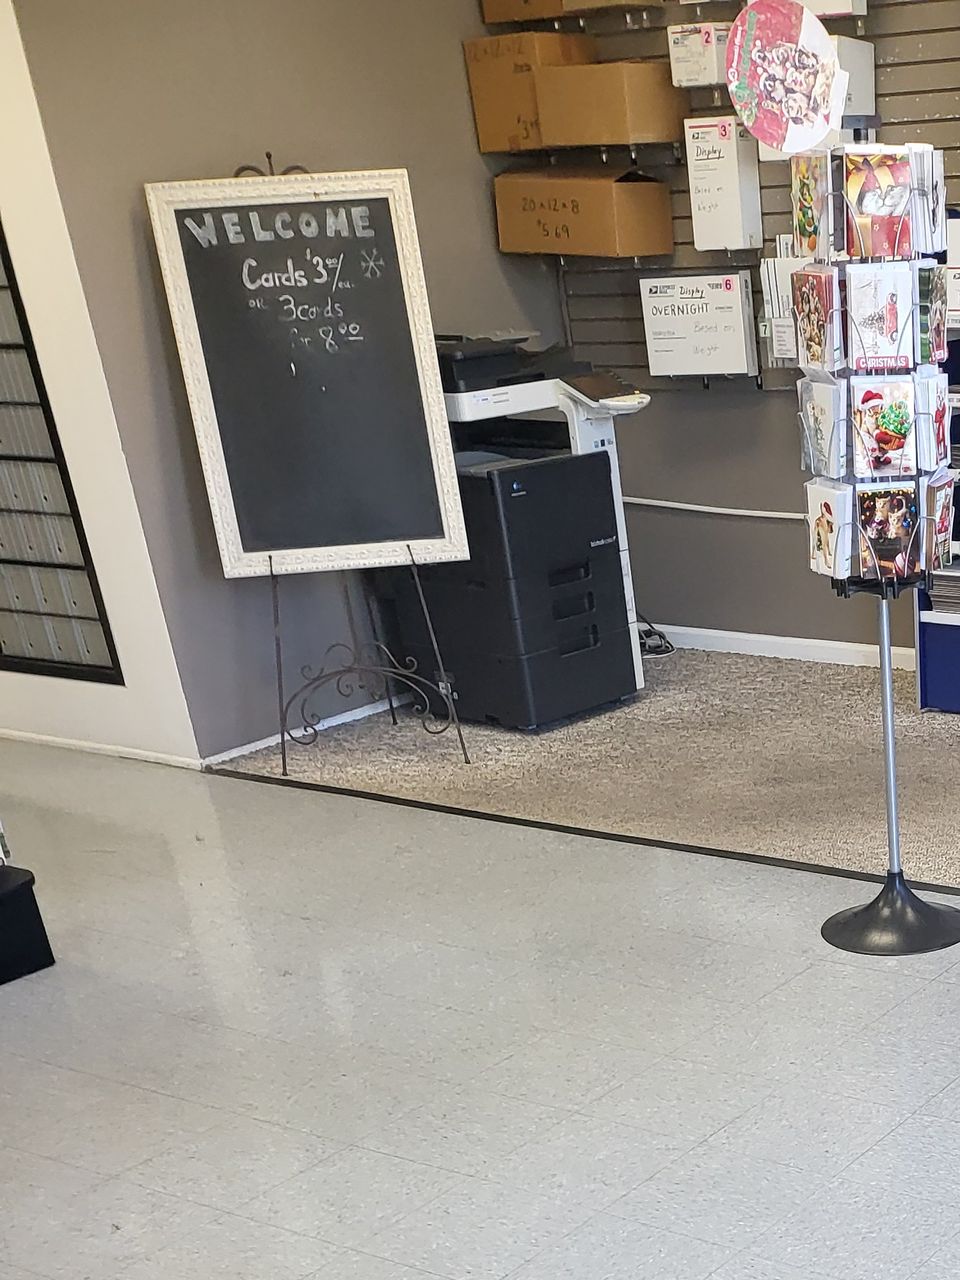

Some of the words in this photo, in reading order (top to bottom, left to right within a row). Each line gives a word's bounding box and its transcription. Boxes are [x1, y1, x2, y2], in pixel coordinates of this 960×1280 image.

[704, 31, 711, 43] 2
[695, 145, 722, 160] Display
[522, 197, 536, 212] 20
[570, 199, 580, 214] 8
[184, 206, 375, 248] WELCOME
[242, 258, 308, 290] Cards
[725, 279, 732, 290] 6
[680, 286, 704, 299] Display
[651, 303, 710, 317] OVERNIGHT
[762, 325, 767, 335] 7
